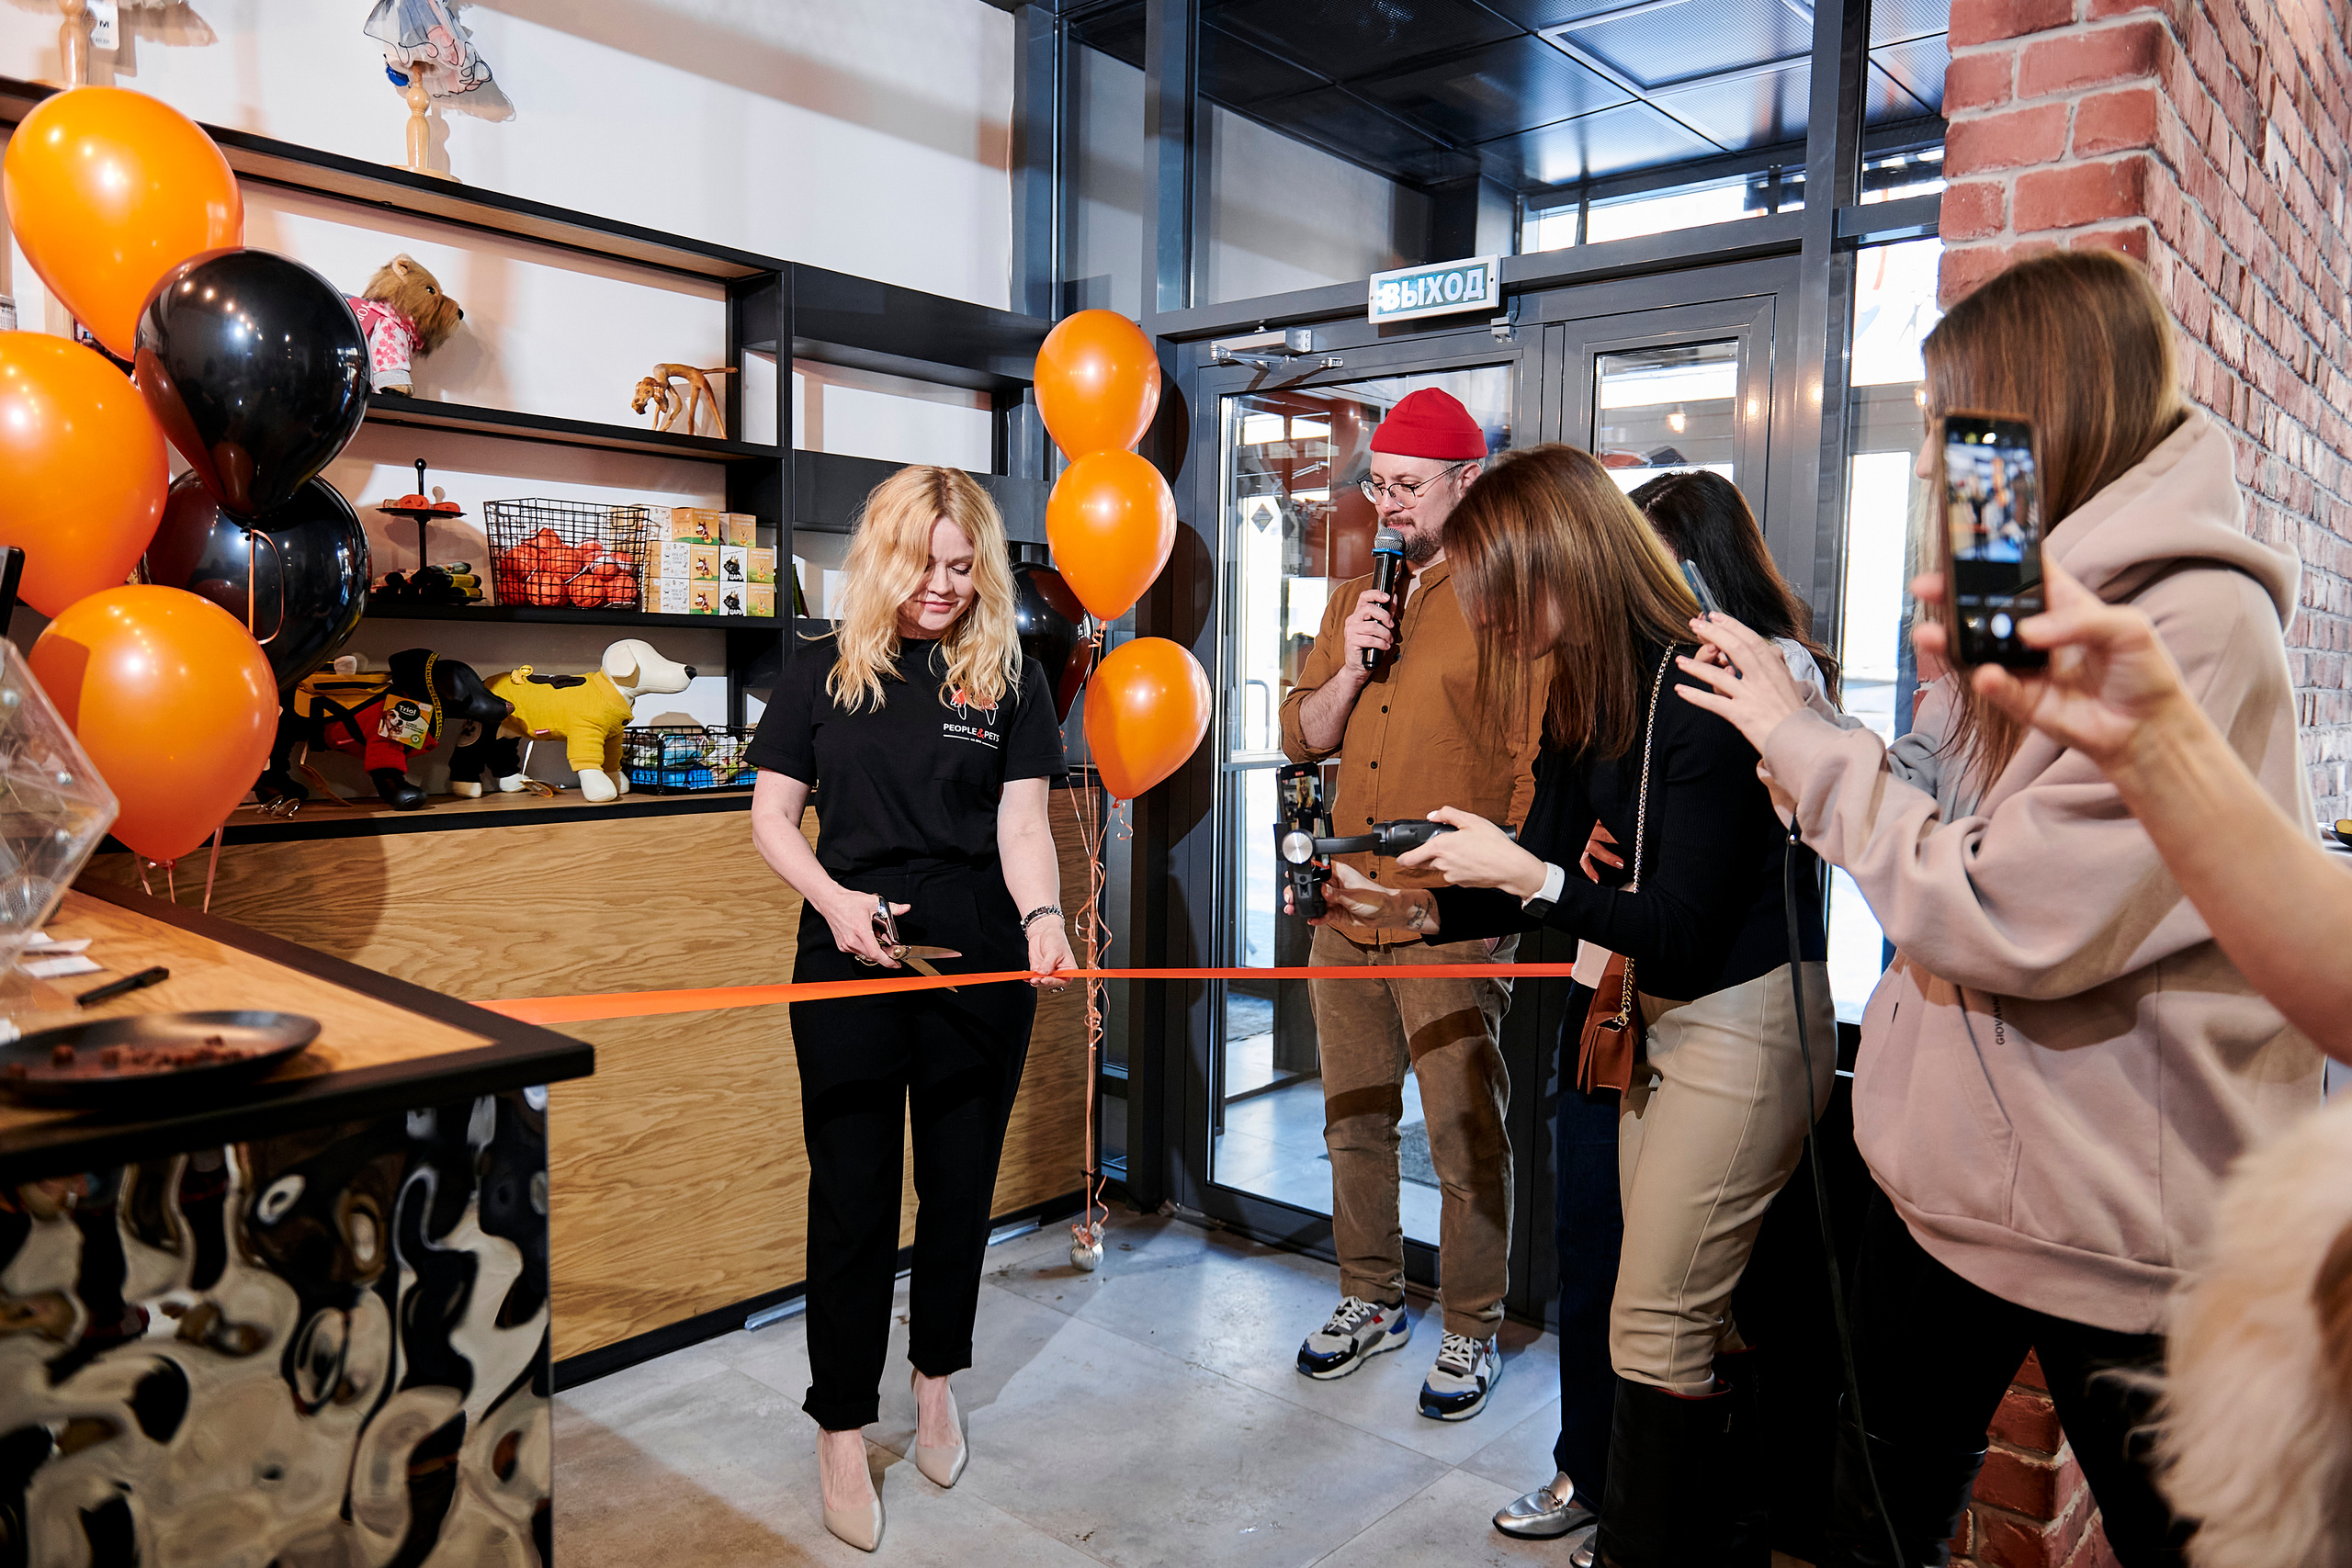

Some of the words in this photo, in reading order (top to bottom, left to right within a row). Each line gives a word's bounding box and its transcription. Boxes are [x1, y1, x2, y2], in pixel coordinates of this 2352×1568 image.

[1381, 267, 1485, 312] ВЫХОД
[399, 705, 417, 716] Triol
[943, 723, 1001, 742] PEOPLE&PETS
